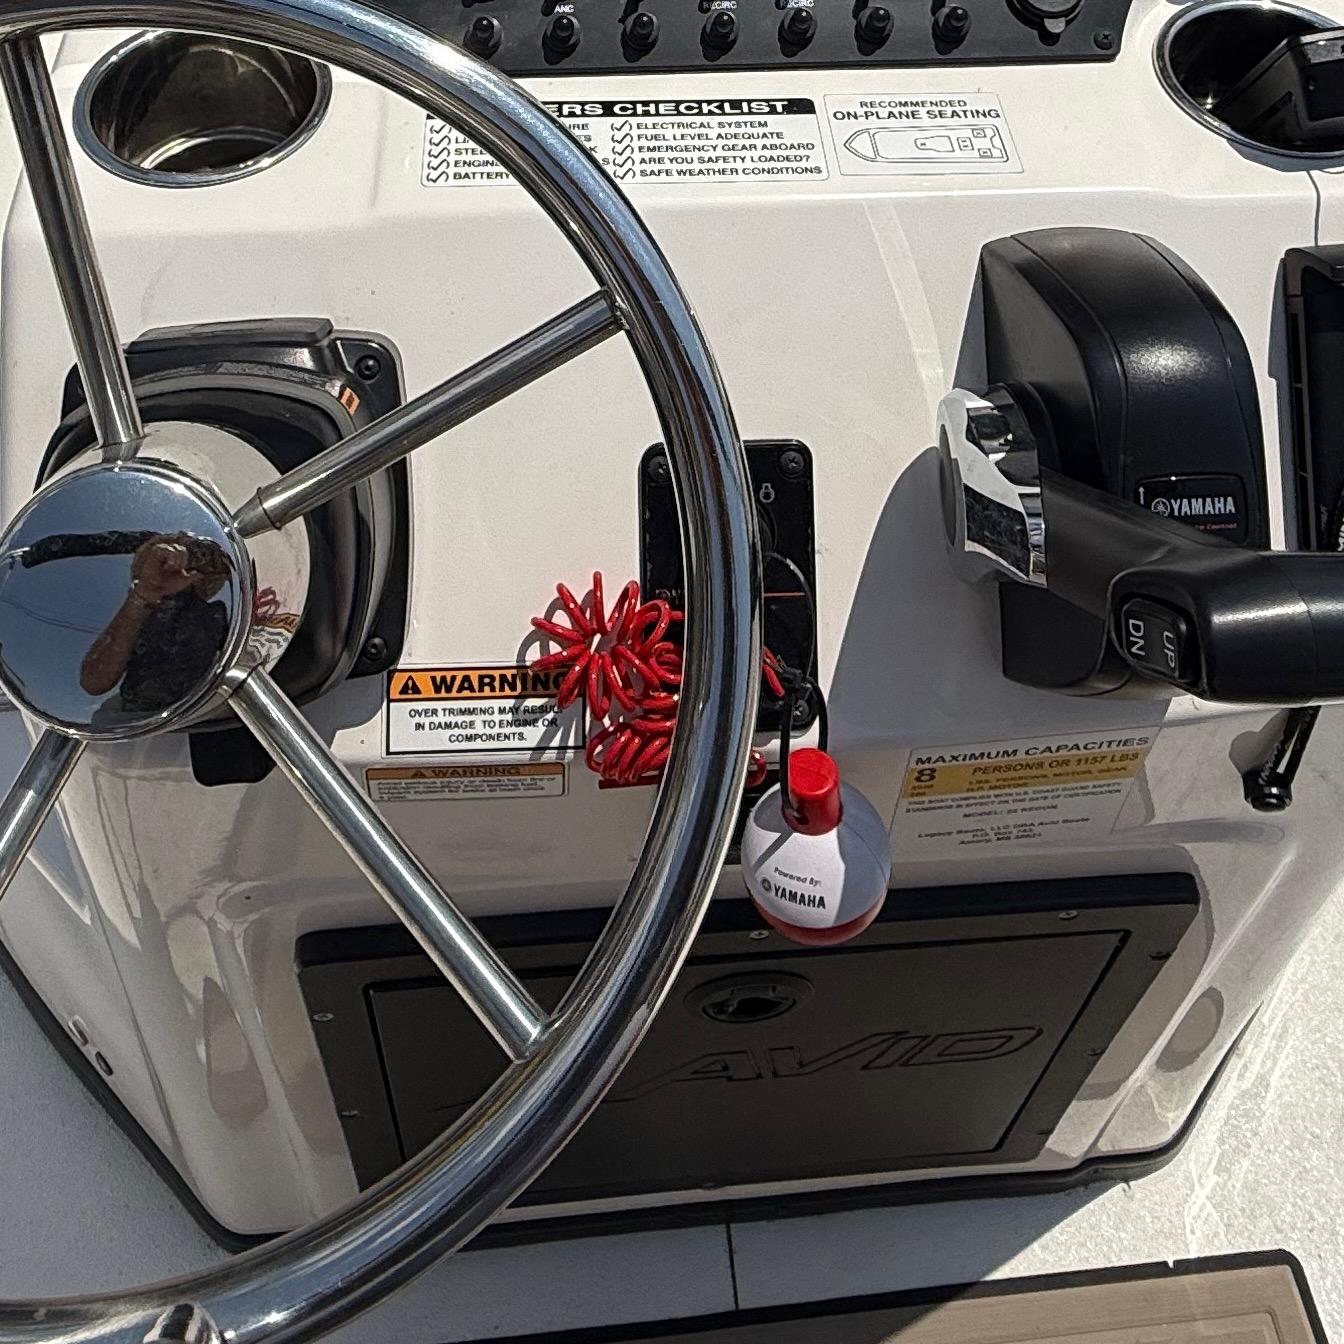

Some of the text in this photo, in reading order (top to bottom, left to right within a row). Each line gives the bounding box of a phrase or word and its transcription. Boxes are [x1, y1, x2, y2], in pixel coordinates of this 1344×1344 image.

[554, 4, 575, 13] ANC
[613, 100, 789, 115] CHECKLIST
[859, 99, 967, 108] RECOMMENDED
[833, 108, 1001, 121] ON-PLANE SEATING
[636, 120, 768, 130] ELECTRICAL SYSTEM
[637, 131, 784, 142] FUEL LEVEL ADEQUATE
[638, 142, 816, 153] EMERGENCY GEAR ABOARD
[639, 154, 810, 165] ARE YOU SAFETY LOADED?
[639, 166, 822, 177] SAFE WEATHER CONDITIONS
[1170, 496, 1236, 516] YAMAHA
[1128, 619, 1146, 656] DN
[1163, 630, 1176, 668] UP
[409, 704, 563, 718] OVER TRIMMING MAY RESUL
[414, 718, 558, 731] IN DAMAGE TO ENGINE OR
[448, 732, 527, 743] COMPONENTS.
[915, 736, 1150, 766] MAXIMUM CAPACITIES
[431, 767, 520, 778] WARNING
[914, 752, 1139, 783] 8 PERSONS OR 1157 LBS
[774, 866, 823, 887] Powered By:
[773, 883, 826, 910] YAMAHA
[631, 1024, 1045, 1094] AVID
